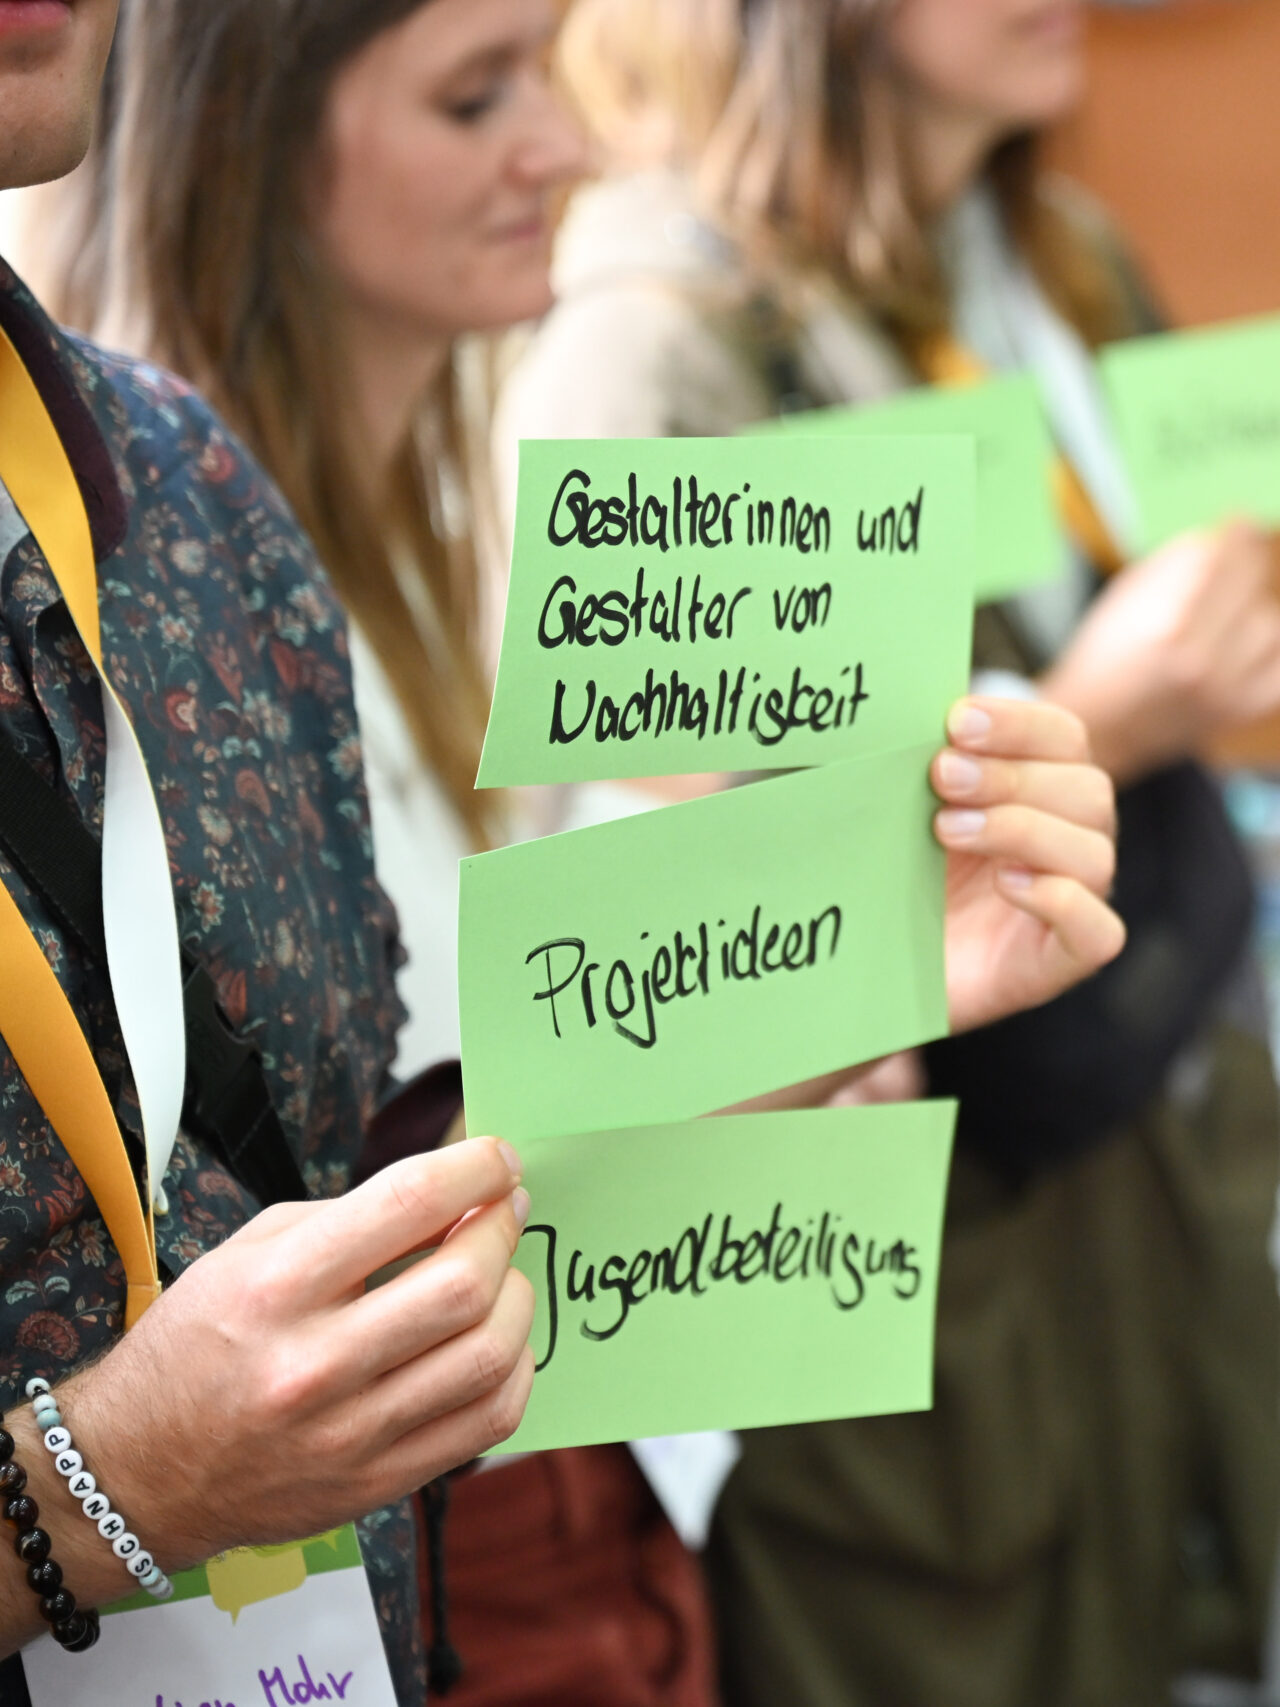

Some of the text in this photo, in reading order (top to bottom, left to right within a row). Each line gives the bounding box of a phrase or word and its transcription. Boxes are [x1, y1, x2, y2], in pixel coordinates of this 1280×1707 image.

[547, 469, 924, 554] Gestalterinnen und
[537, 567, 832, 649] Gestalter von
[548, 662, 870, 746] Nachhaltigkeit
[525, 905, 842, 1049] Projektideen
[48, 1433, 152, 1573] SCHNAPP
[258, 1654, 354, 1707] Mohr
